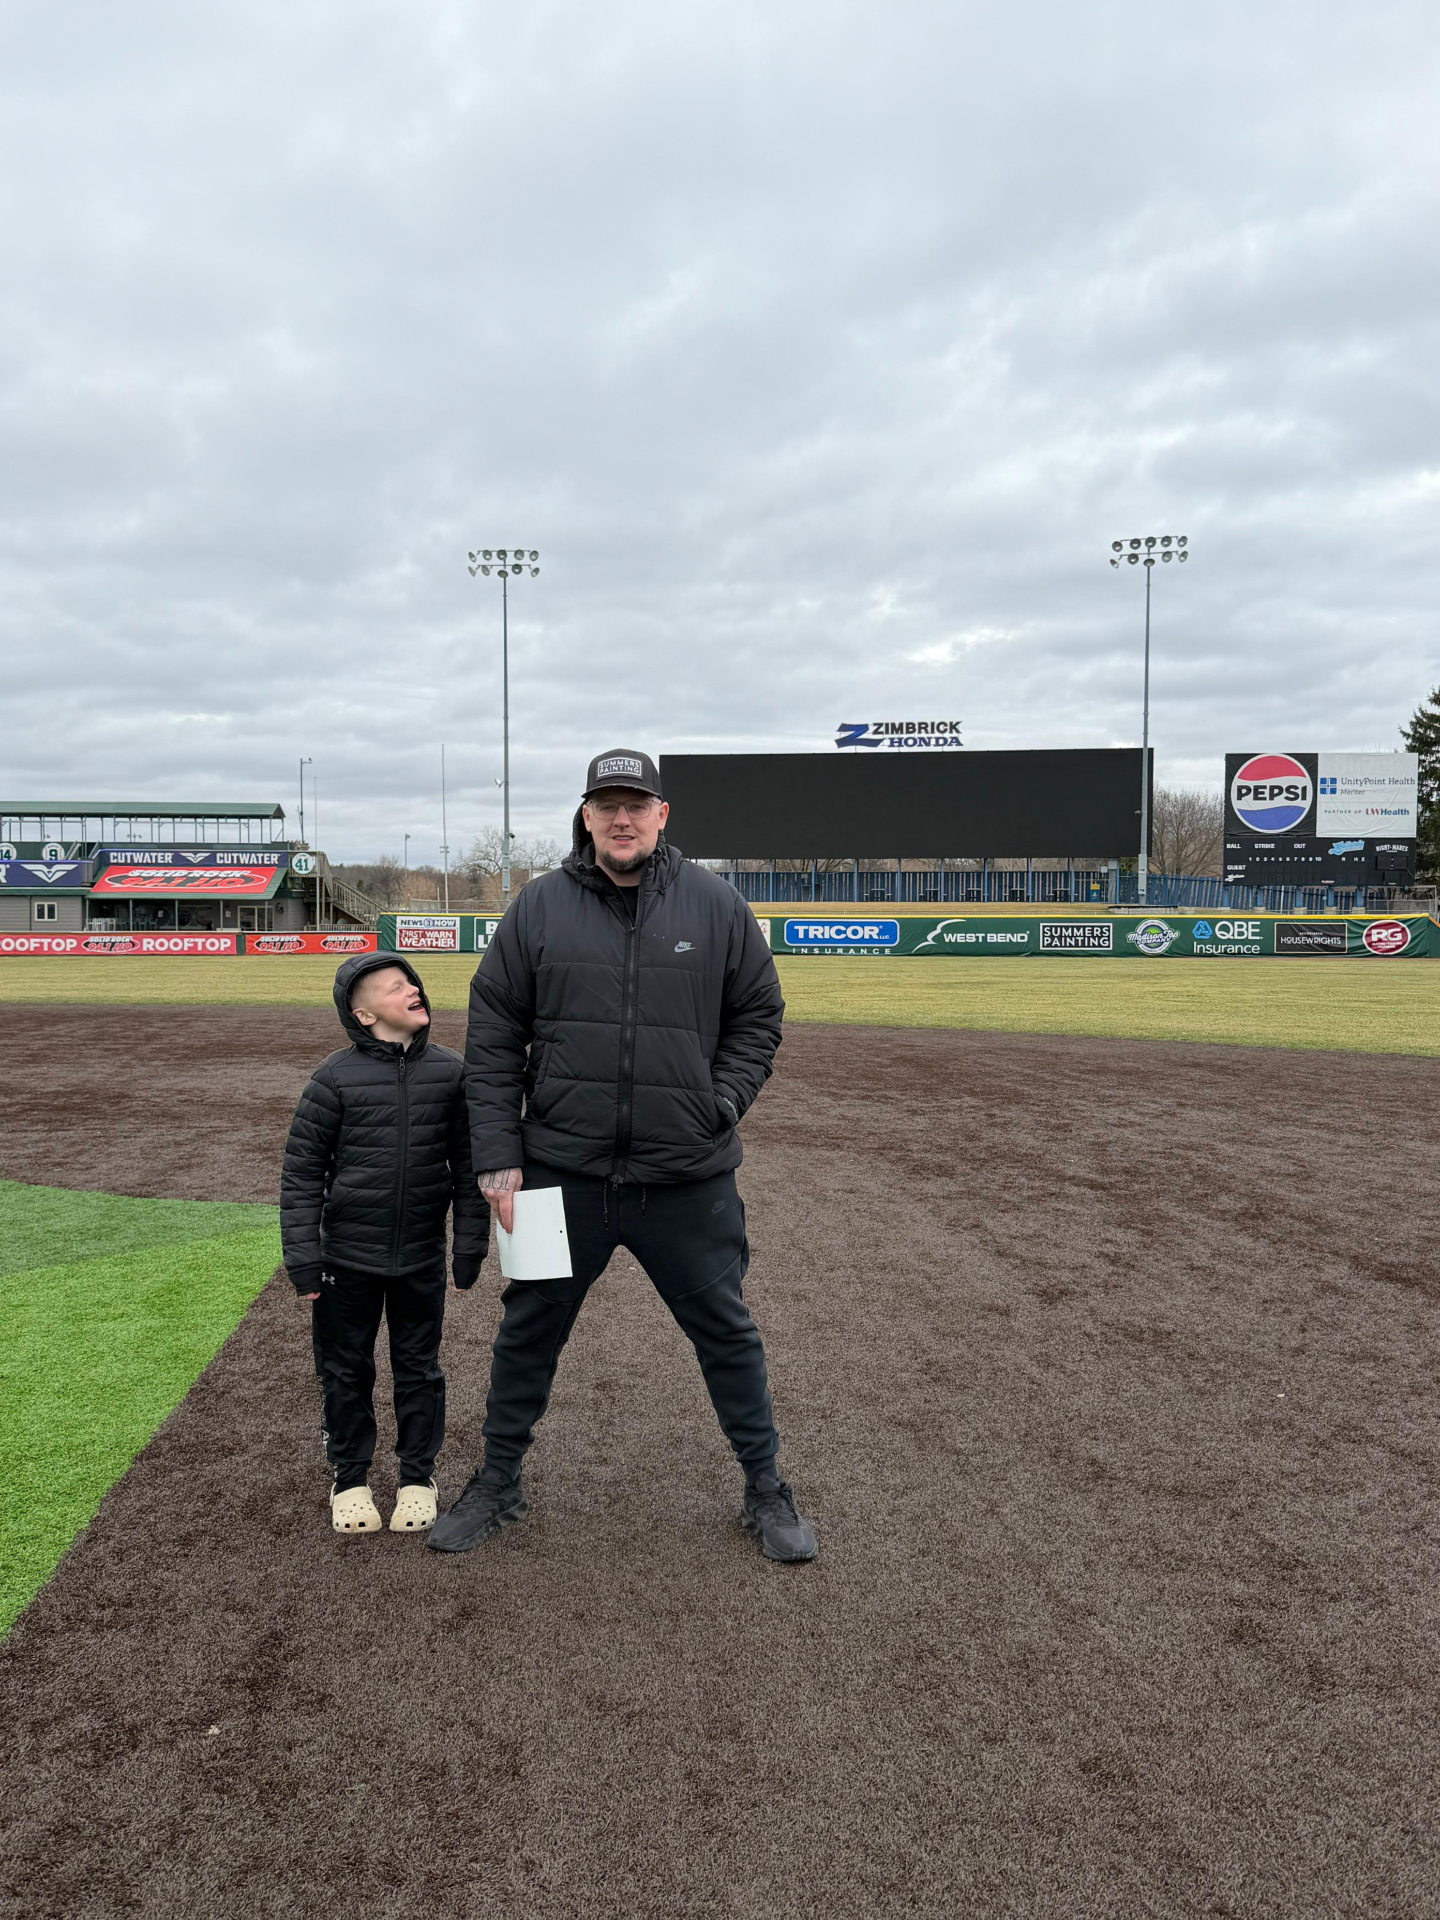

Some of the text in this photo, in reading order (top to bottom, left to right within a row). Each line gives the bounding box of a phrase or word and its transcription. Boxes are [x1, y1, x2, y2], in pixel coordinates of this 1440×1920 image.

[872, 721, 962, 735] ZIMBRICK
[887, 736, 963, 748] HONDA
[600, 759, 640, 768] SUMMERS
[600, 765, 640, 774] PAINTING
[1341, 777, 1416, 787] UnityPoint Health
[1236, 784, 1308, 802] PEPSI
[1340, 788, 1365, 796] Meriter
[49, 849, 58, 860] 9
[109, 852, 173, 864] CUTWATER
[216, 852, 279, 865] CUTWATER
[295, 858, 309, 871] 41
[128, 869, 248, 878] SOLID ROCK
[402, 930, 453, 939] FIRST WARN
[794, 925, 880, 940] TRICOR
[1044, 926, 1110, 937] SUMMERS
[1127, 929, 1179, 942] Madison Top
[1371, 928, 1403, 942] RG
[400, 938, 455, 948] WEATHER
[943, 933, 1028, 943] WEST BEND
[1044, 937, 1110, 947] PAINTING
[1280, 936, 1342, 945] HOUSEWRIGHTS
[0, 937, 78, 952] OOFTOP
[143, 937, 232, 951] ROOFTOP
[678, 940, 692, 948] NIKE
[1193, 941, 1260, 954] Insurance
